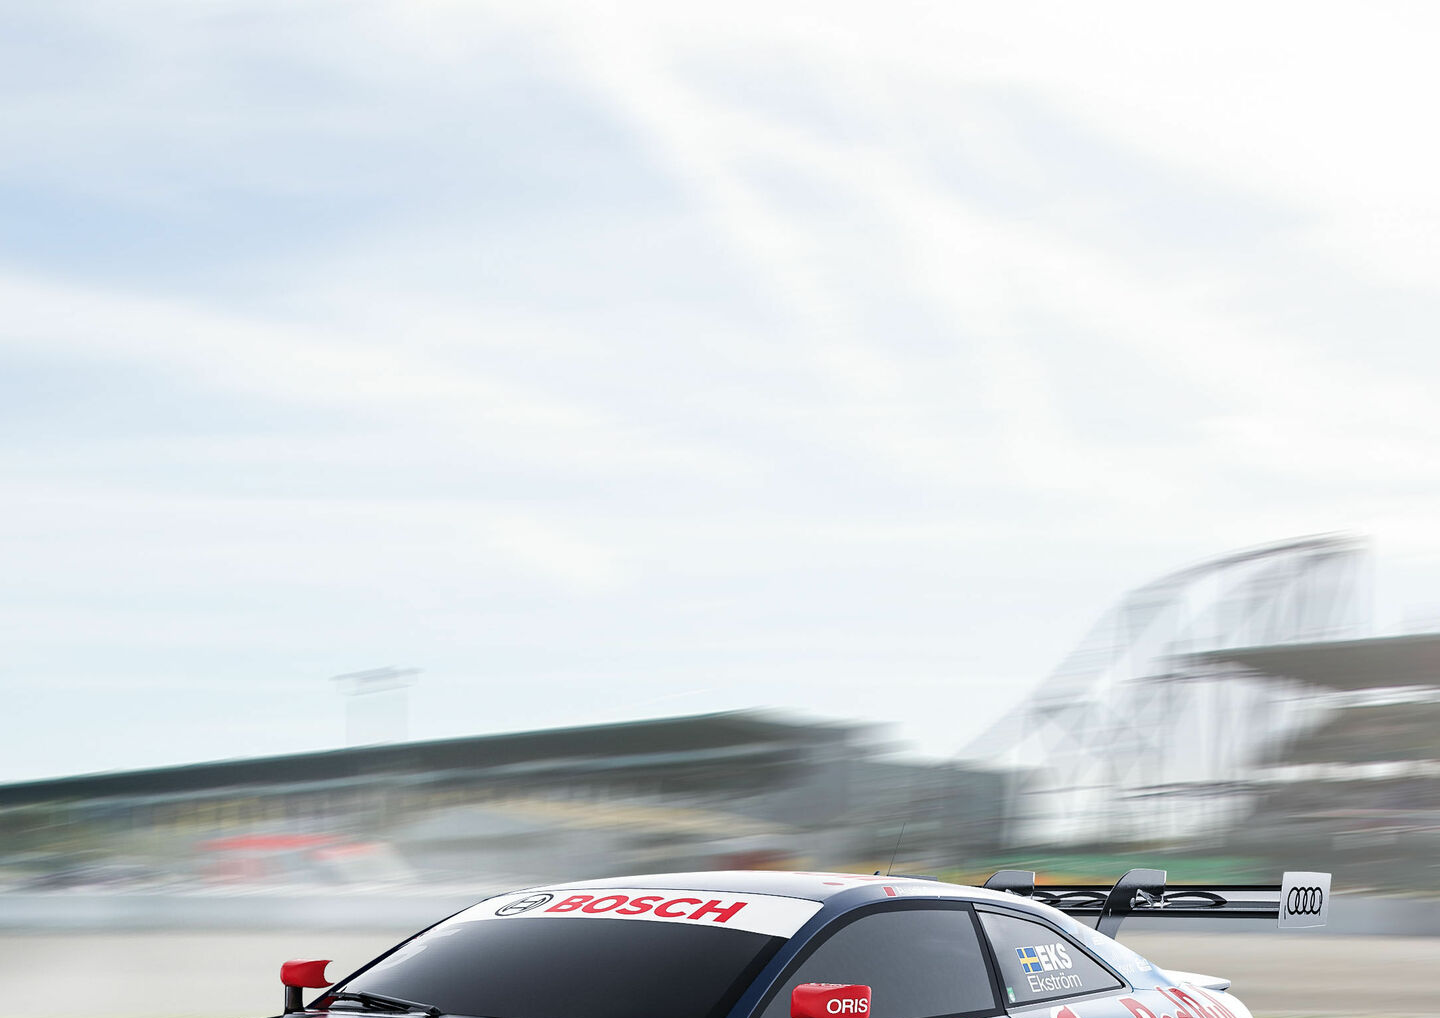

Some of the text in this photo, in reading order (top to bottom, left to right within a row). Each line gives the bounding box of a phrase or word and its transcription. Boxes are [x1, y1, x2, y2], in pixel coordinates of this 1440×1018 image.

[544, 895, 747, 923] BOSCH
[1035, 942, 1073, 972] EKS
[1027, 972, 1083, 993] Ekström
[826, 998, 868, 1014] ORIS
